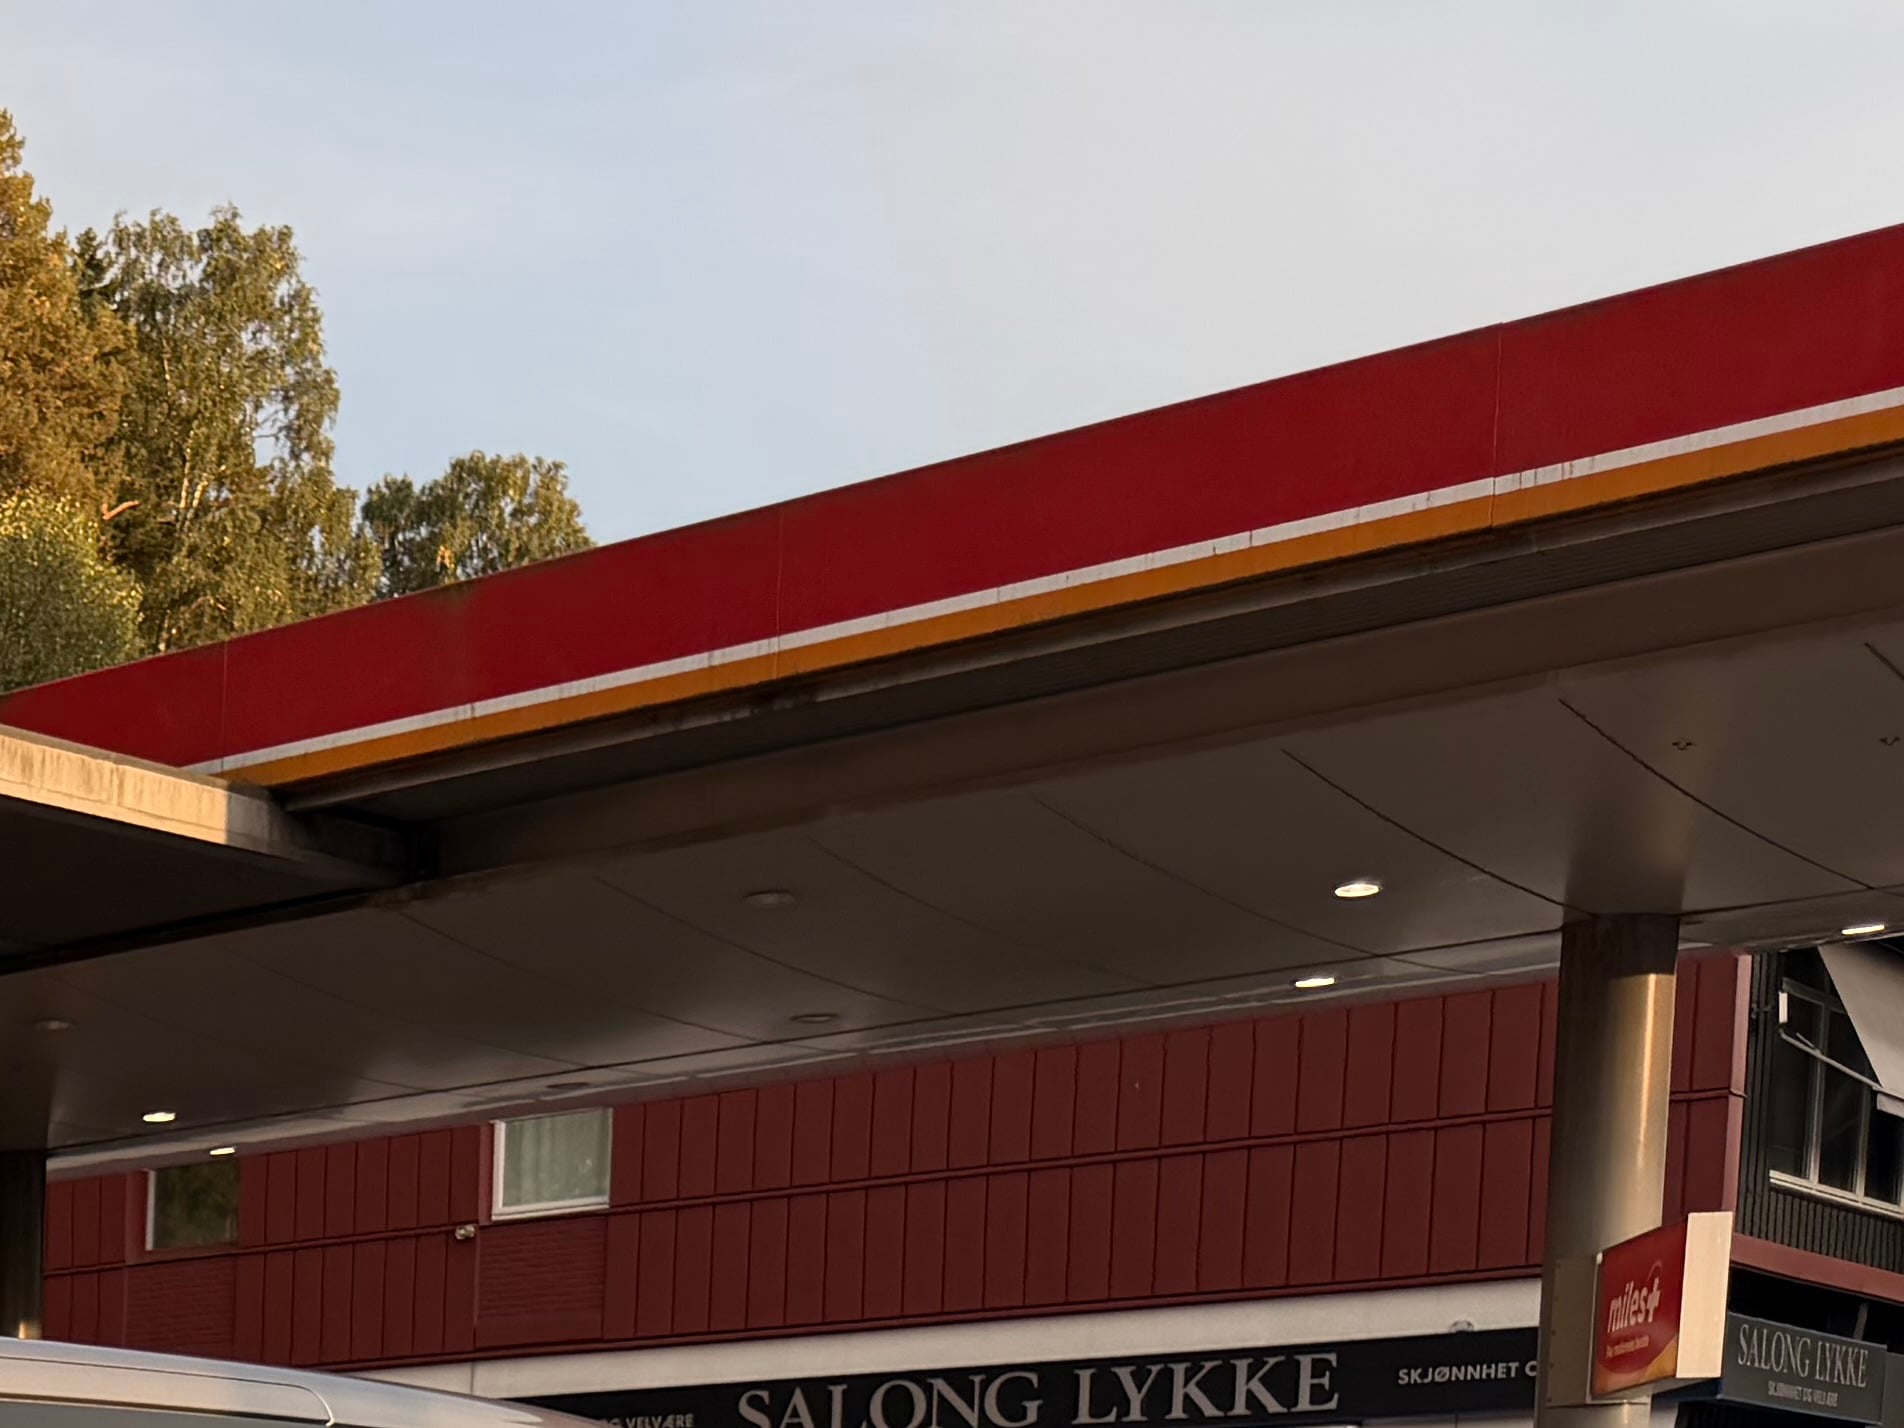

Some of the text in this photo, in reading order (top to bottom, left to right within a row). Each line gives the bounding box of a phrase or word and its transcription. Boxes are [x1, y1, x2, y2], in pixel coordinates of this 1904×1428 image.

[1397, 1360, 1538, 1385] SKJØNNHET O
[1738, 1324, 1869, 1388] SALONG LYKKE
[1072, 1352, 1339, 1425] LYKKE
